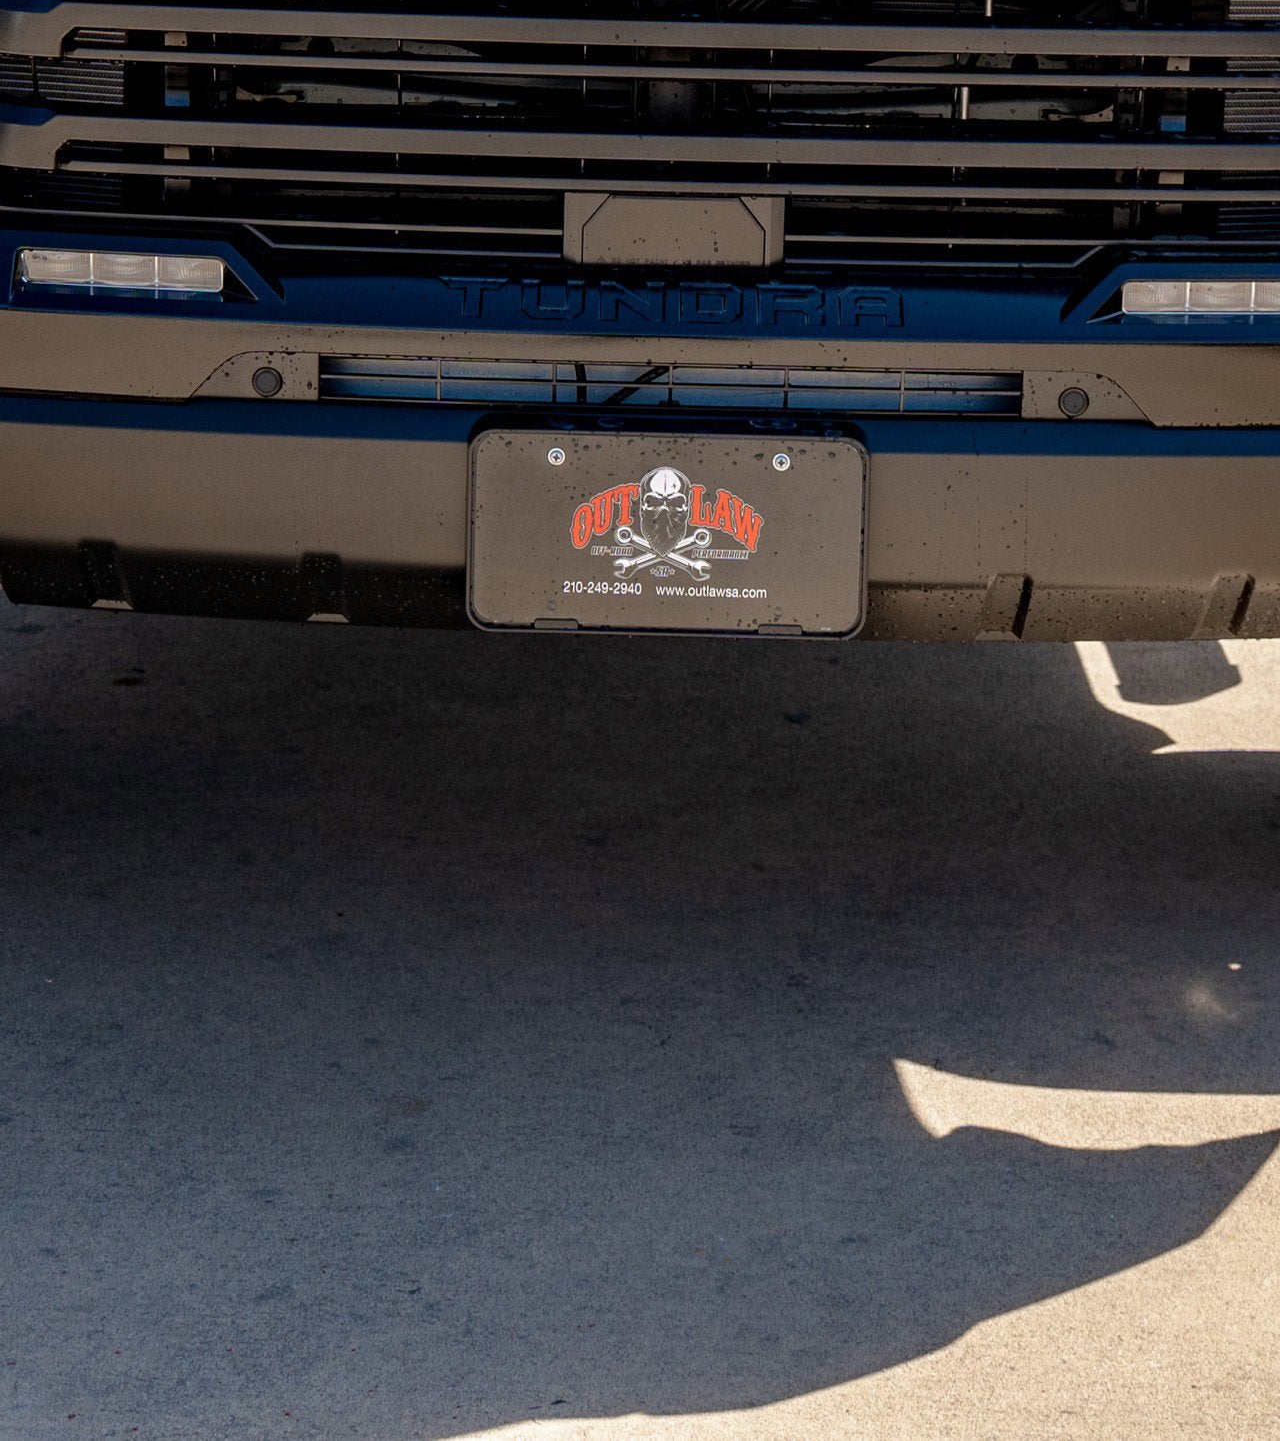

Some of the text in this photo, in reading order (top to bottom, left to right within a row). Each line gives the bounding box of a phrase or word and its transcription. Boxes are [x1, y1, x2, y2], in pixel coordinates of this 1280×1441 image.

[438, 274, 905, 328] TUNDRA
[590, 545, 634, 557] OFF-ROAD
[691, 548, 750, 560] PERFORMANCE
[563, 581, 767, 599] 210-249-2940 www.outlawsa.com
